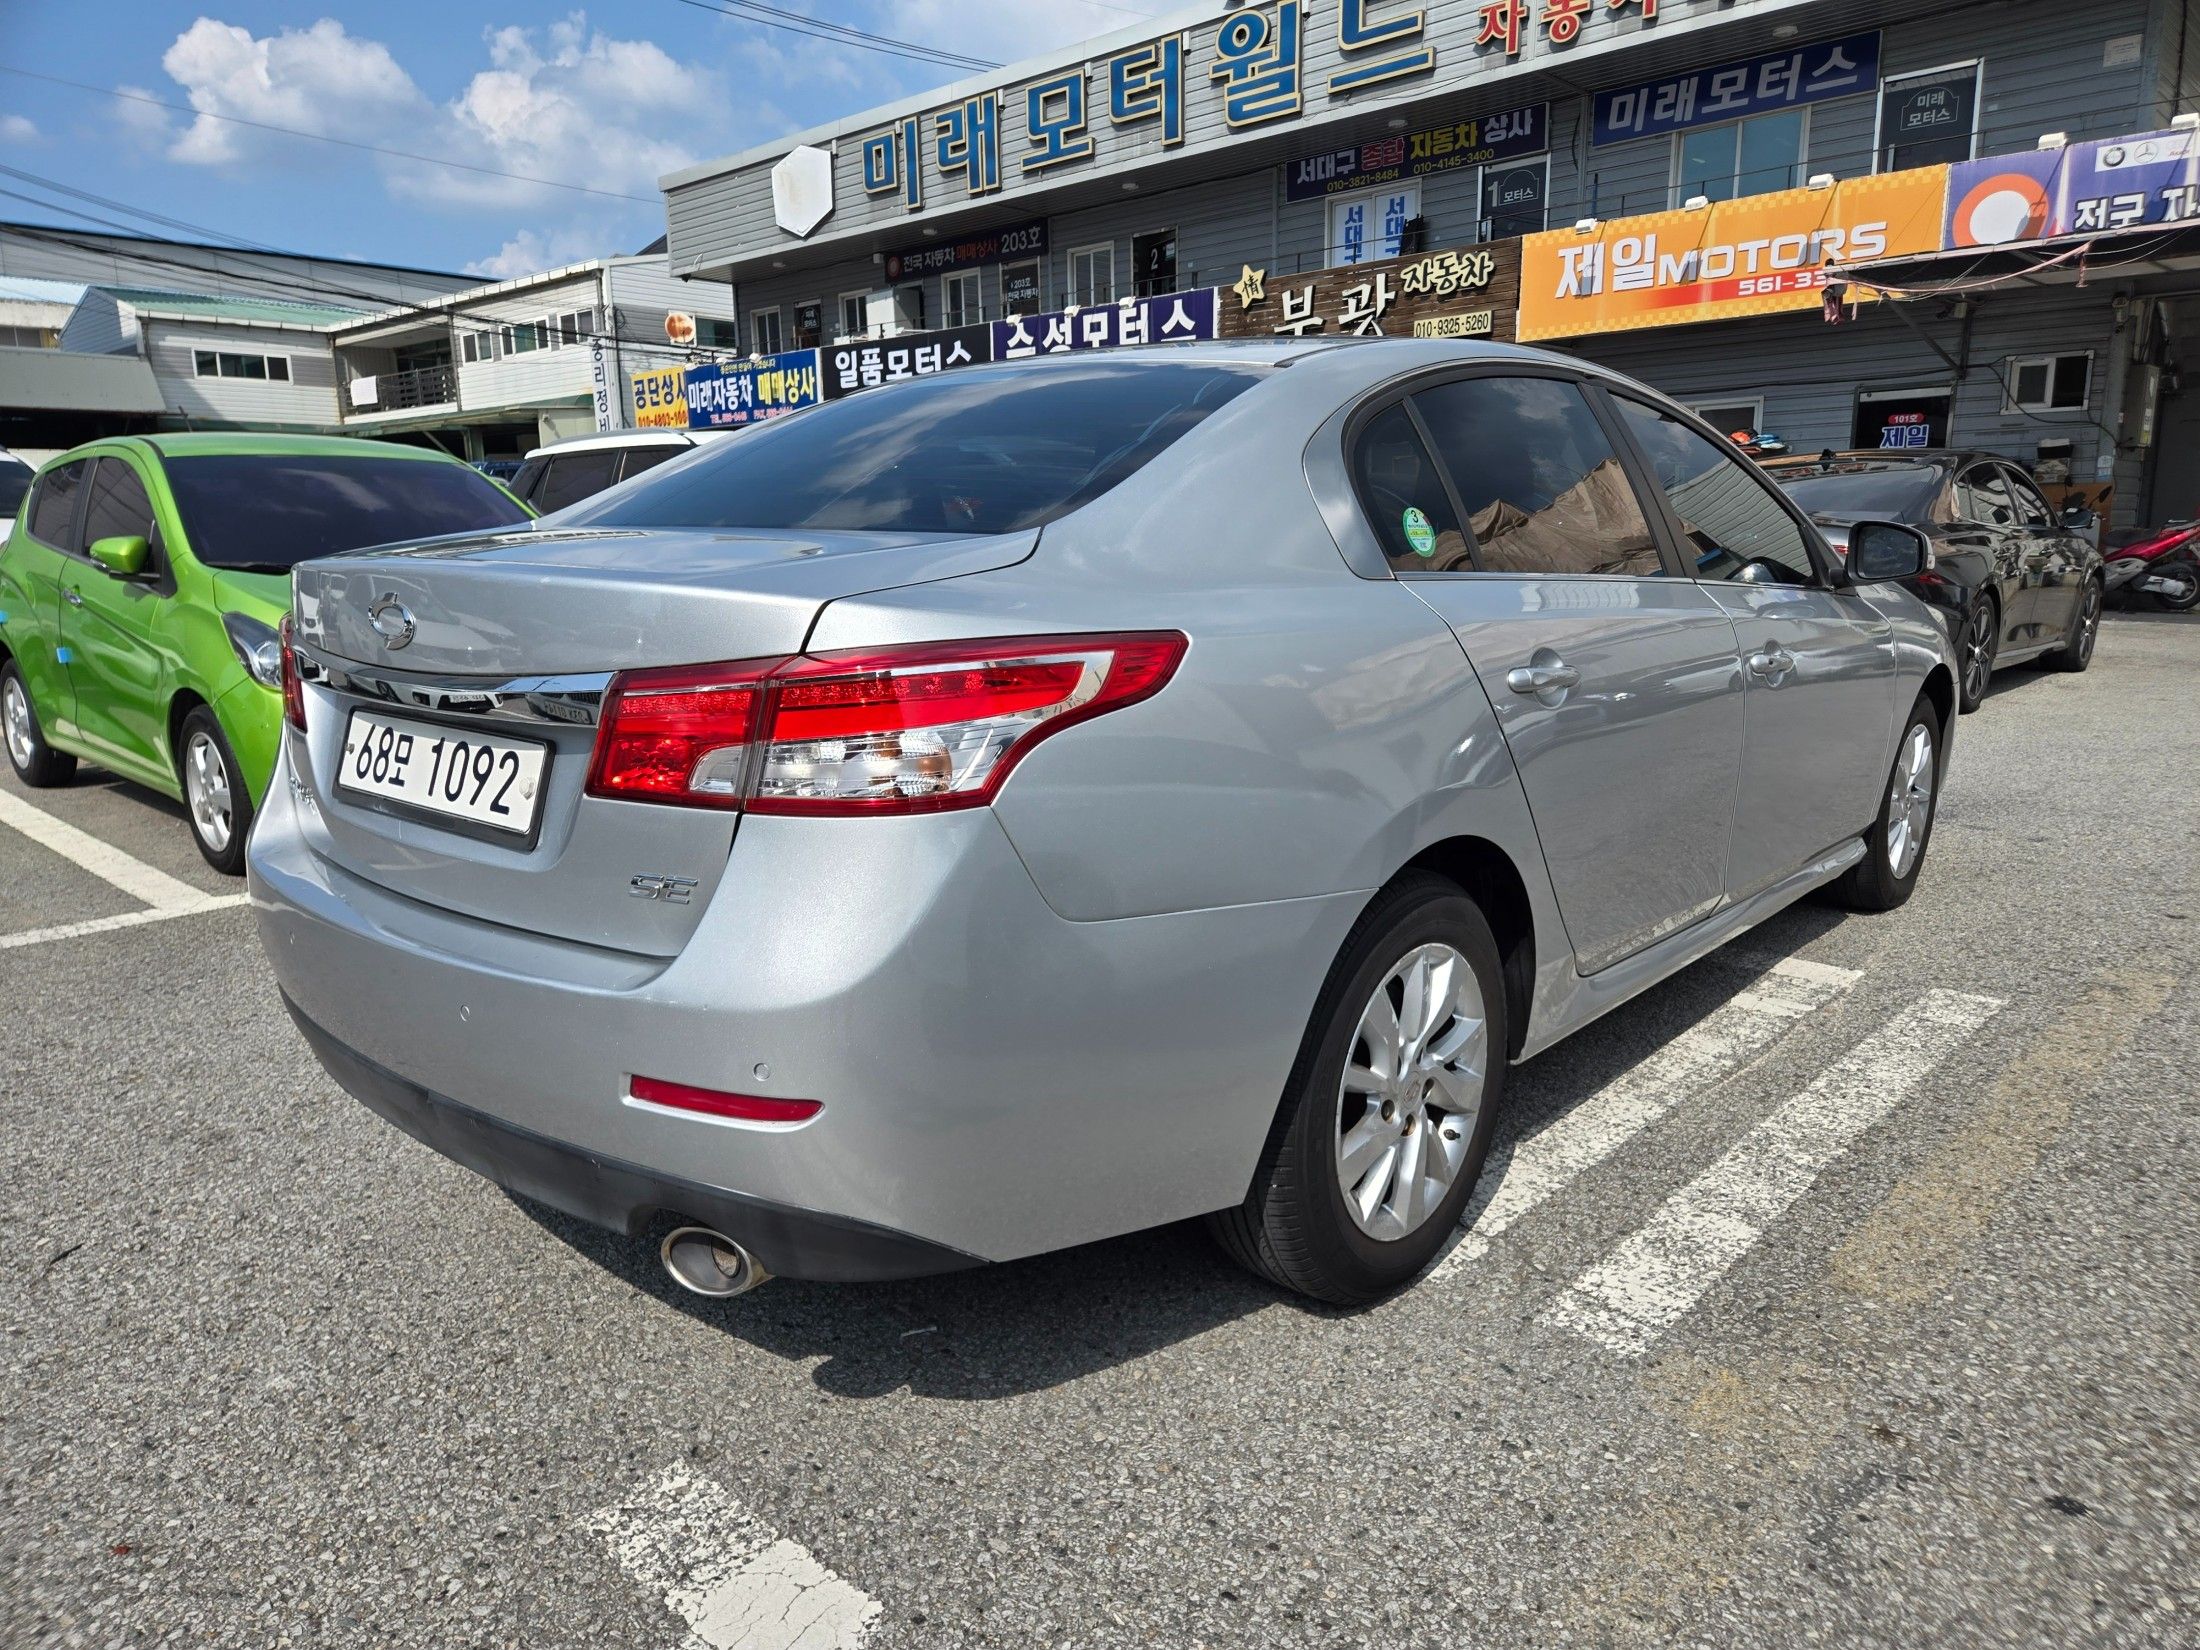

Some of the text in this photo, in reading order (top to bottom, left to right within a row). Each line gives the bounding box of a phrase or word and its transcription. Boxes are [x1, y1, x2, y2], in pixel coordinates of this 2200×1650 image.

[1608, 46, 1858, 132] 미래모터스
[1917, 91, 1945, 107] 미래
[1907, 108, 1951, 126] 모터스
[1297, 108, 1533, 184] 서대구 종합 자동차 상사
[1413, 149, 1494, 175] 010-4145-3400
[1327, 170, 1399, 193] 010-3821-8484
[1503, 188, 1534, 202] 모터스
[2161, 185, 2200, 221] 자
[903, 226, 1041, 272] 전국 자동차 매매상사 203호
[1401, 252, 1493, 294] 자동차
[1738, 270, 1827, 296] 561-33
[1415, 312, 1489, 337] 010-9325-5260
[835, 340, 972, 389] 일품모터스
[688, 365, 815, 413] 미래자동차 매매상사
[1894, 414, 1918, 423] 101호
[1880, 424, 1929, 448] 제일
[356, 723, 520, 816] 68모 1092
